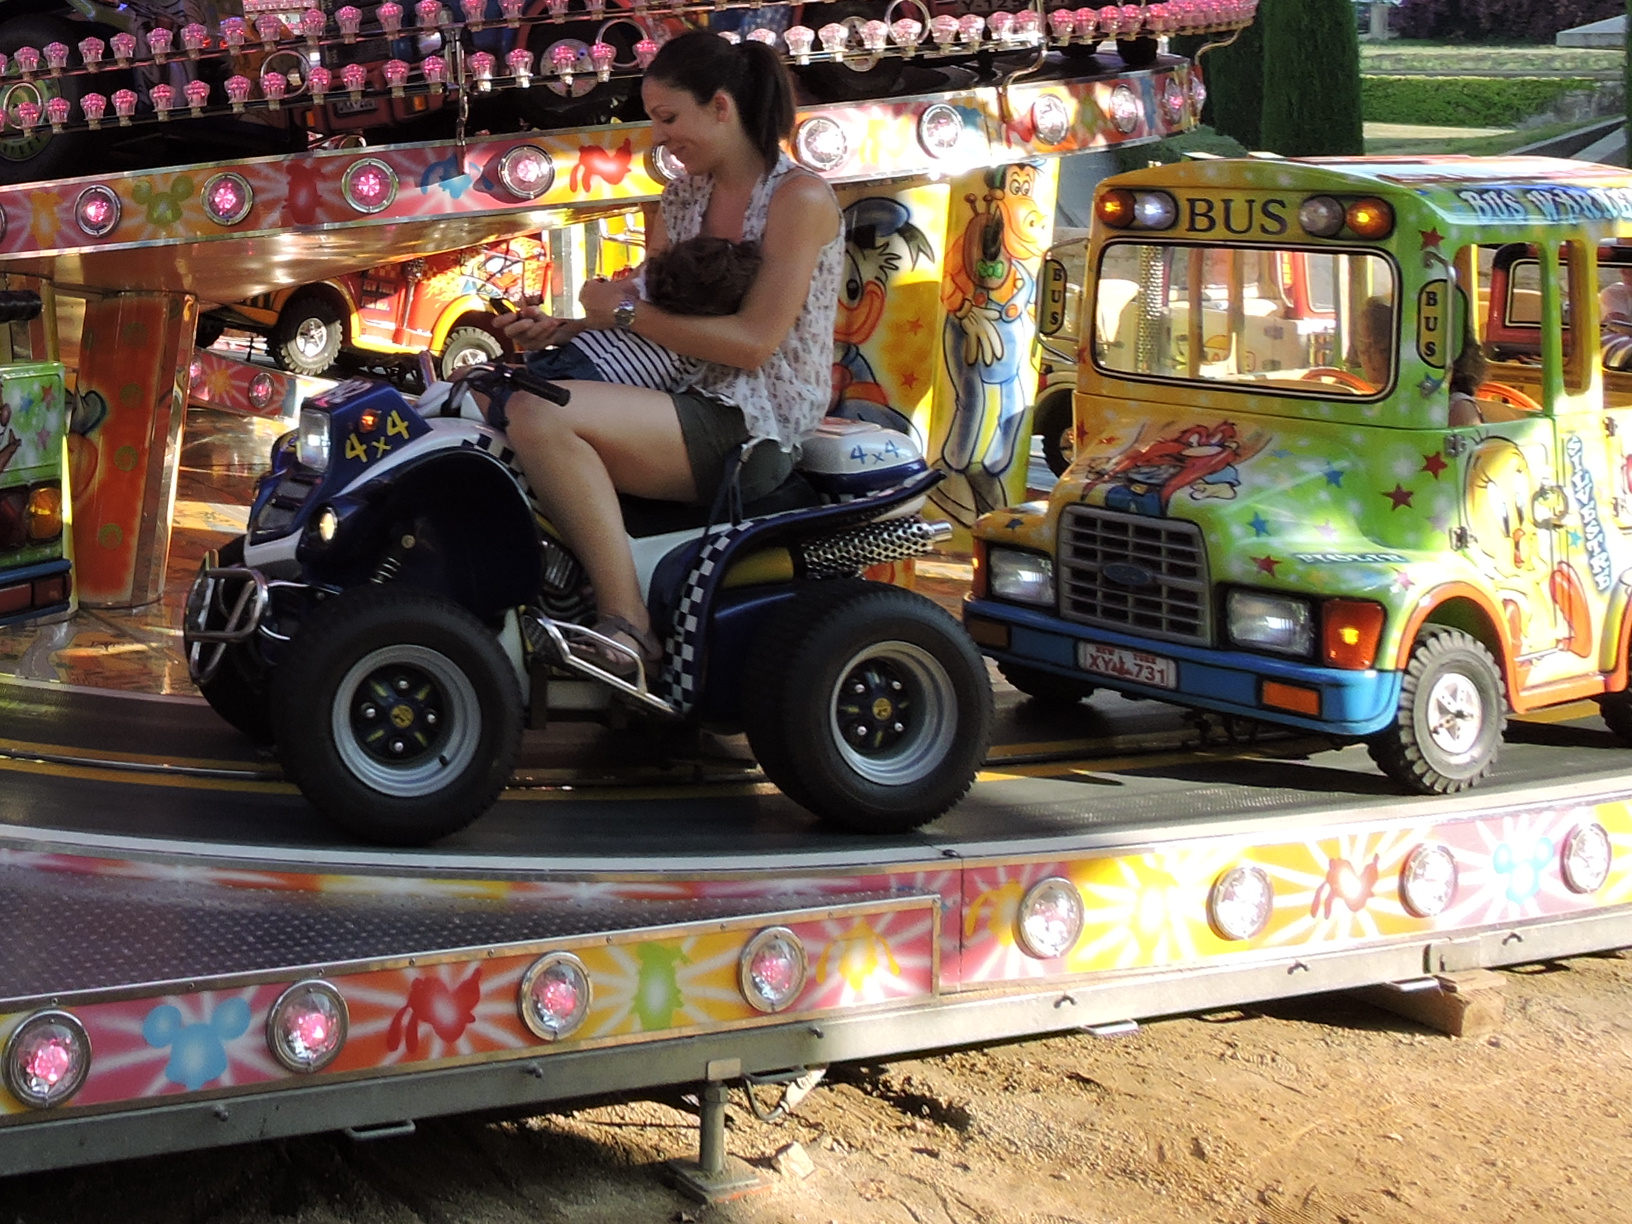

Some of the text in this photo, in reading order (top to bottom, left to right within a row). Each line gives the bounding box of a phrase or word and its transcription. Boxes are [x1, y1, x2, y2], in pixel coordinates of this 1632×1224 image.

[1185, 198, 1288, 235] BUS
[1459, 189, 1527, 221] BUS
[1049, 266, 1062, 326] BUS
[1425, 291, 1439, 358] BUS
[345, 409, 410, 463] 4x4
[850, 439, 900, 465] 4x4
[1133, 662, 1166, 684] 731
